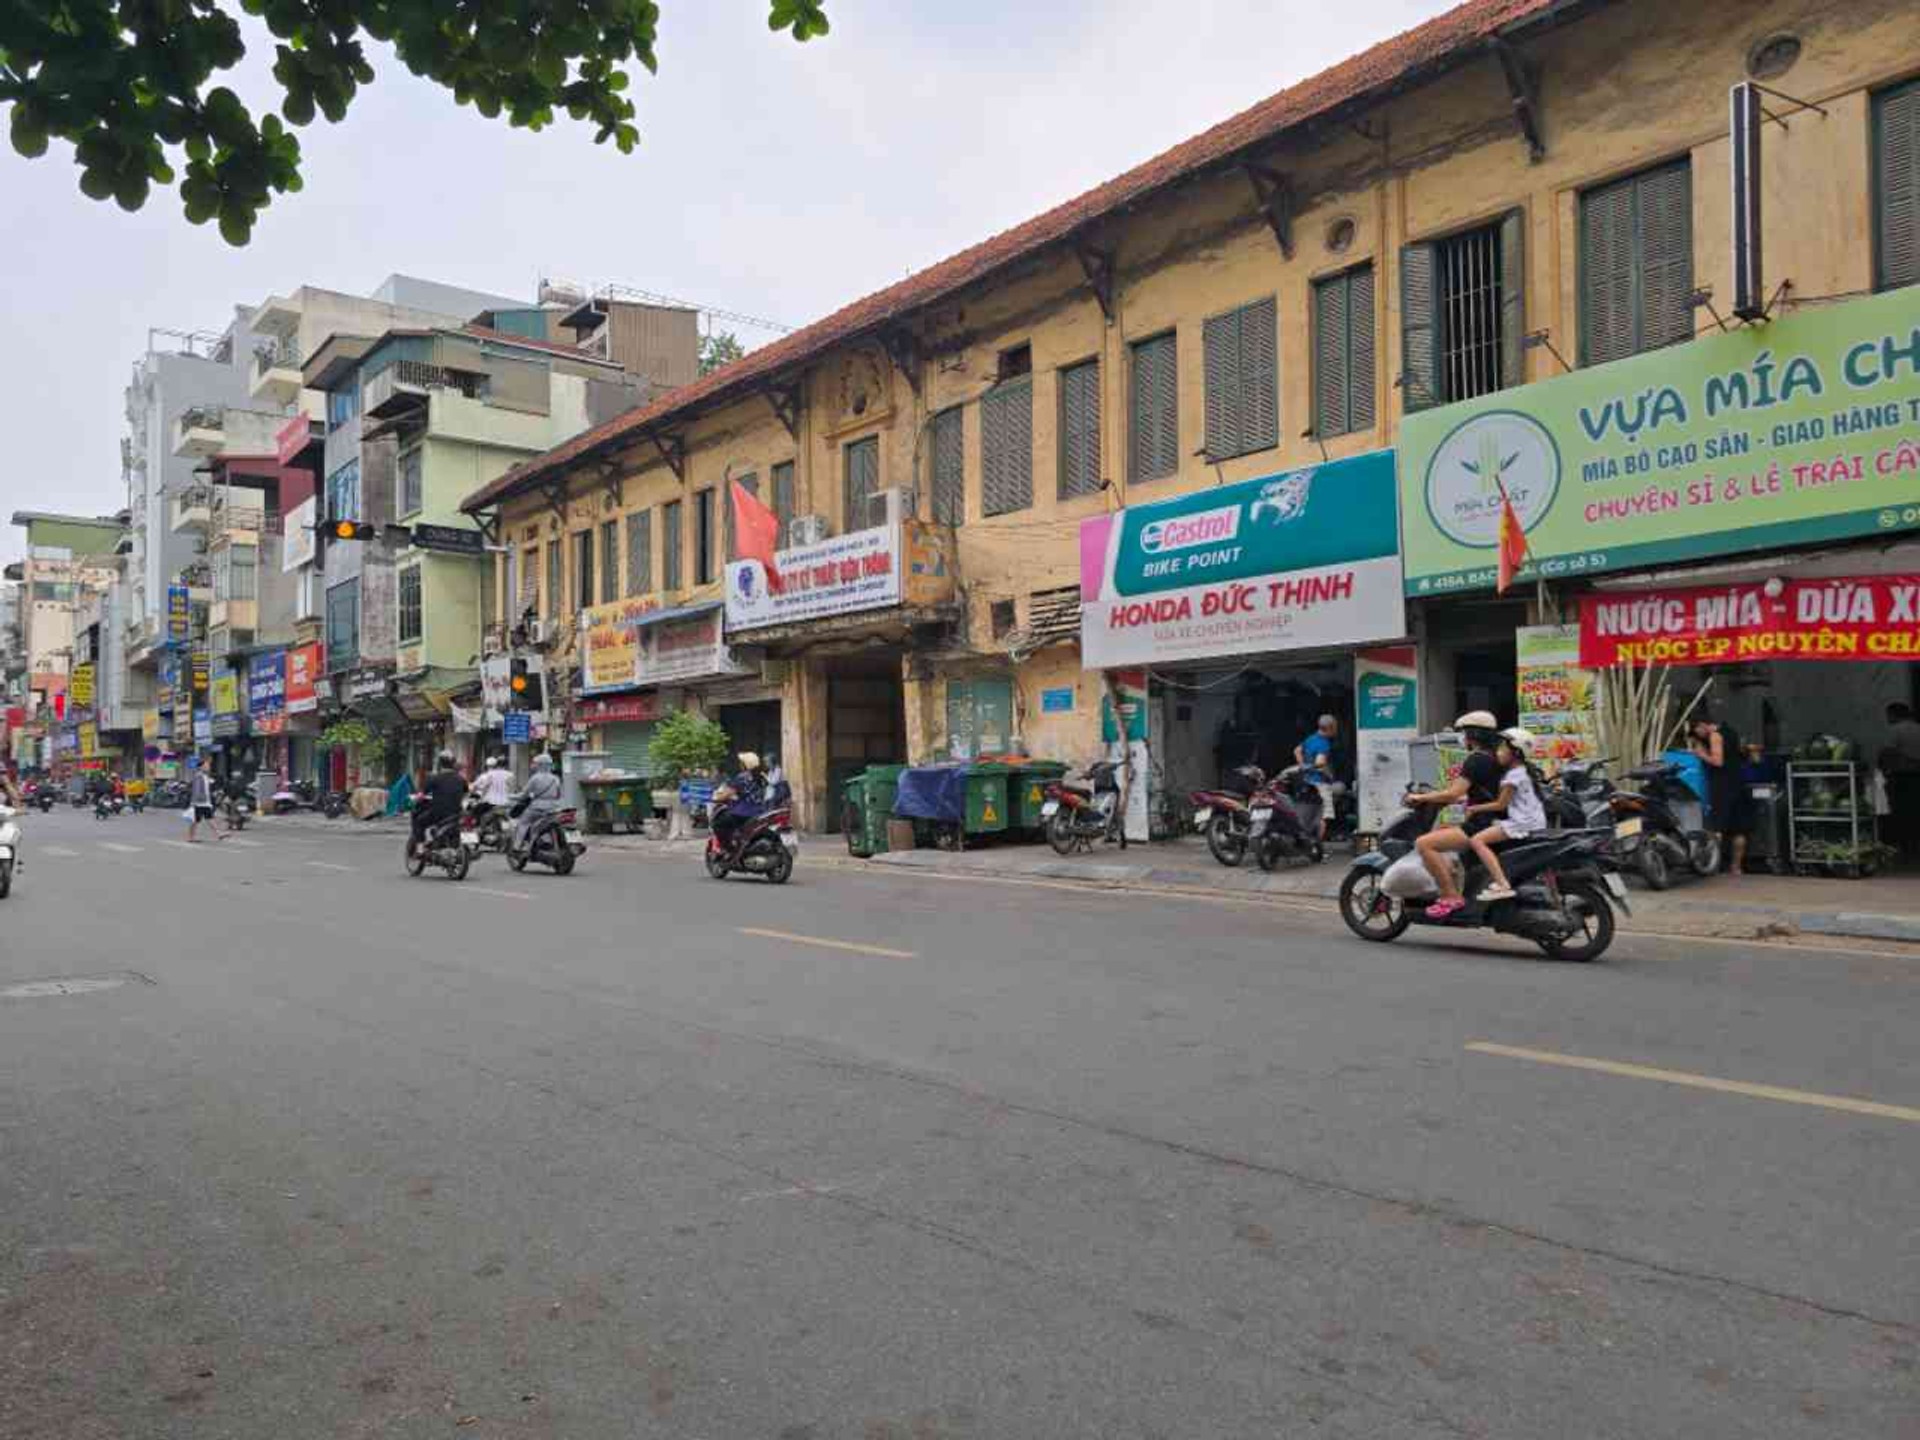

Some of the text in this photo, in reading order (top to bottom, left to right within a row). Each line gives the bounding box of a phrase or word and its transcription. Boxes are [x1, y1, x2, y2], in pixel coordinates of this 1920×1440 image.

[1579, 328, 1920, 443] VỰA MÍA CH
[1582, 456, 1618, 482] MÍA
[1772, 418, 1825, 447] GIAO
[1833, 402, 1900, 436] HÀNG
[1584, 484, 1679, 522] CHUYÊN
[1724, 477, 1741, 501] &
[1792, 453, 1864, 488] TRÁI
[1163, 510, 1234, 548] Castrol
[1142, 547, 1243, 577] BIKE POINT
[1110, 571, 1354, 628] HONDA ĐỨC THỊNH
[1597, 580, 1920, 637] NƯỚC MÍA - DỪA X
[1617, 636, 1690, 662] NƯỚC
[1696, 633, 1731, 657] ÉP
[1739, 626, 1857, 655] NGUYÊN
